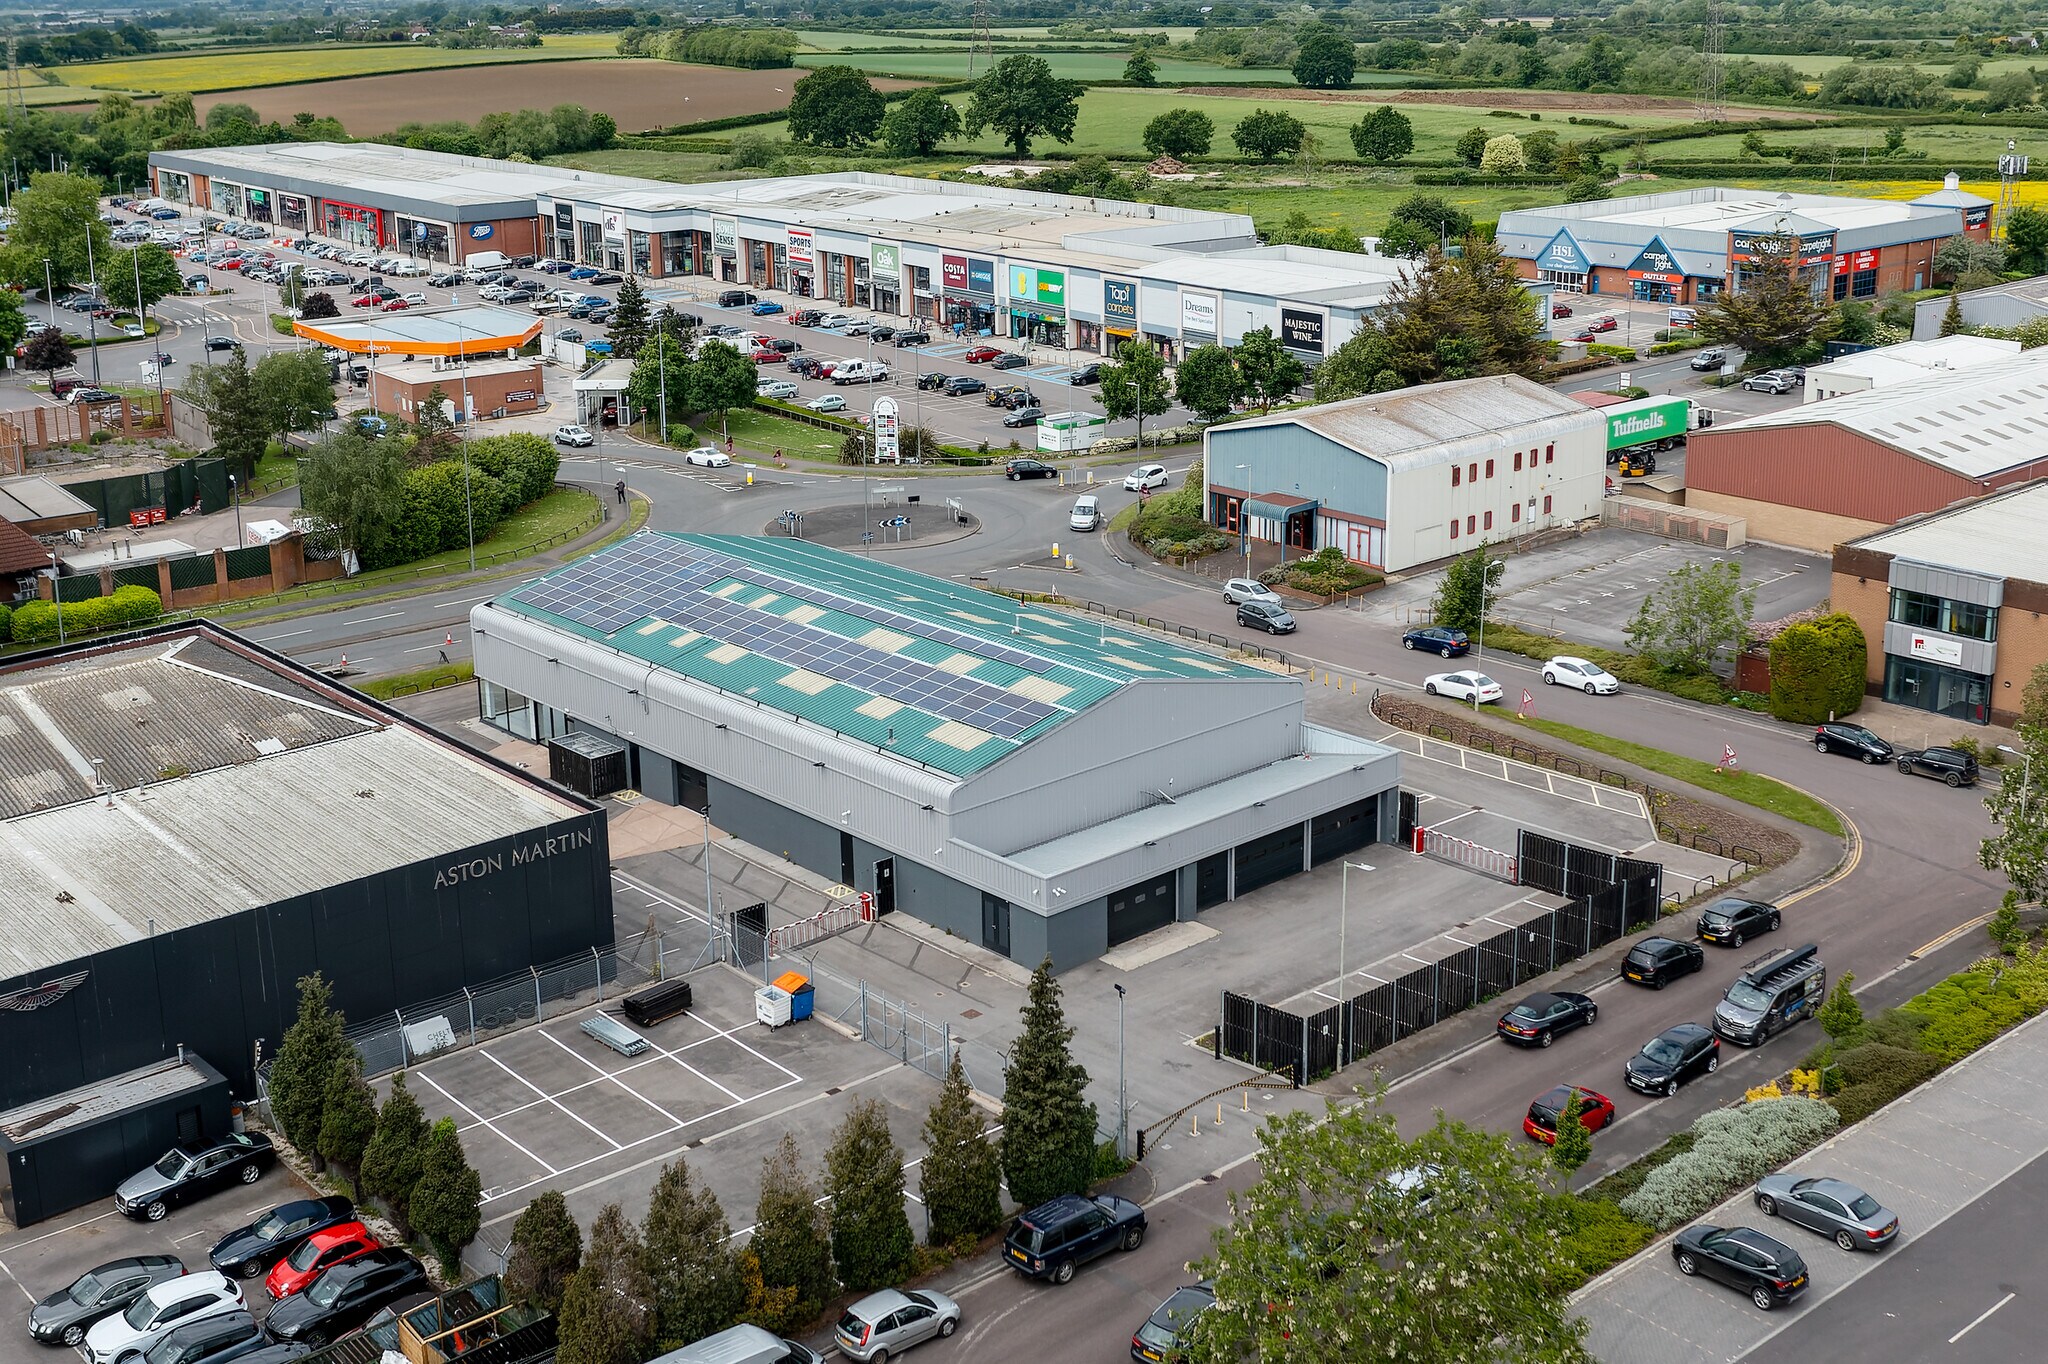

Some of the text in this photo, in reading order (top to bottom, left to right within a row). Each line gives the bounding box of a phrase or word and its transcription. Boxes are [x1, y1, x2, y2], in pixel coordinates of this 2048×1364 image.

[605, 218, 616, 231] dfs
[715, 221, 734, 235] HOME
[715, 233, 735, 246] SENSE
[789, 236, 812, 248] SPORTS
[1551, 245, 1575, 258] HSL
[1643, 253, 1668, 262] carpet
[876, 252, 894, 266] Oak
[944, 263, 966, 275] COSTA
[1642, 273, 1668, 281] OUTLET
[1109, 285, 1130, 304] Tapi
[1107, 303, 1134, 315] carpets
[1185, 300, 1214, 314] Dreams
[1284, 318, 1321, 332] MAJESTIC
[1292, 330, 1313, 342] WINE
[433, 827, 593, 890] ASTON MARTIN
